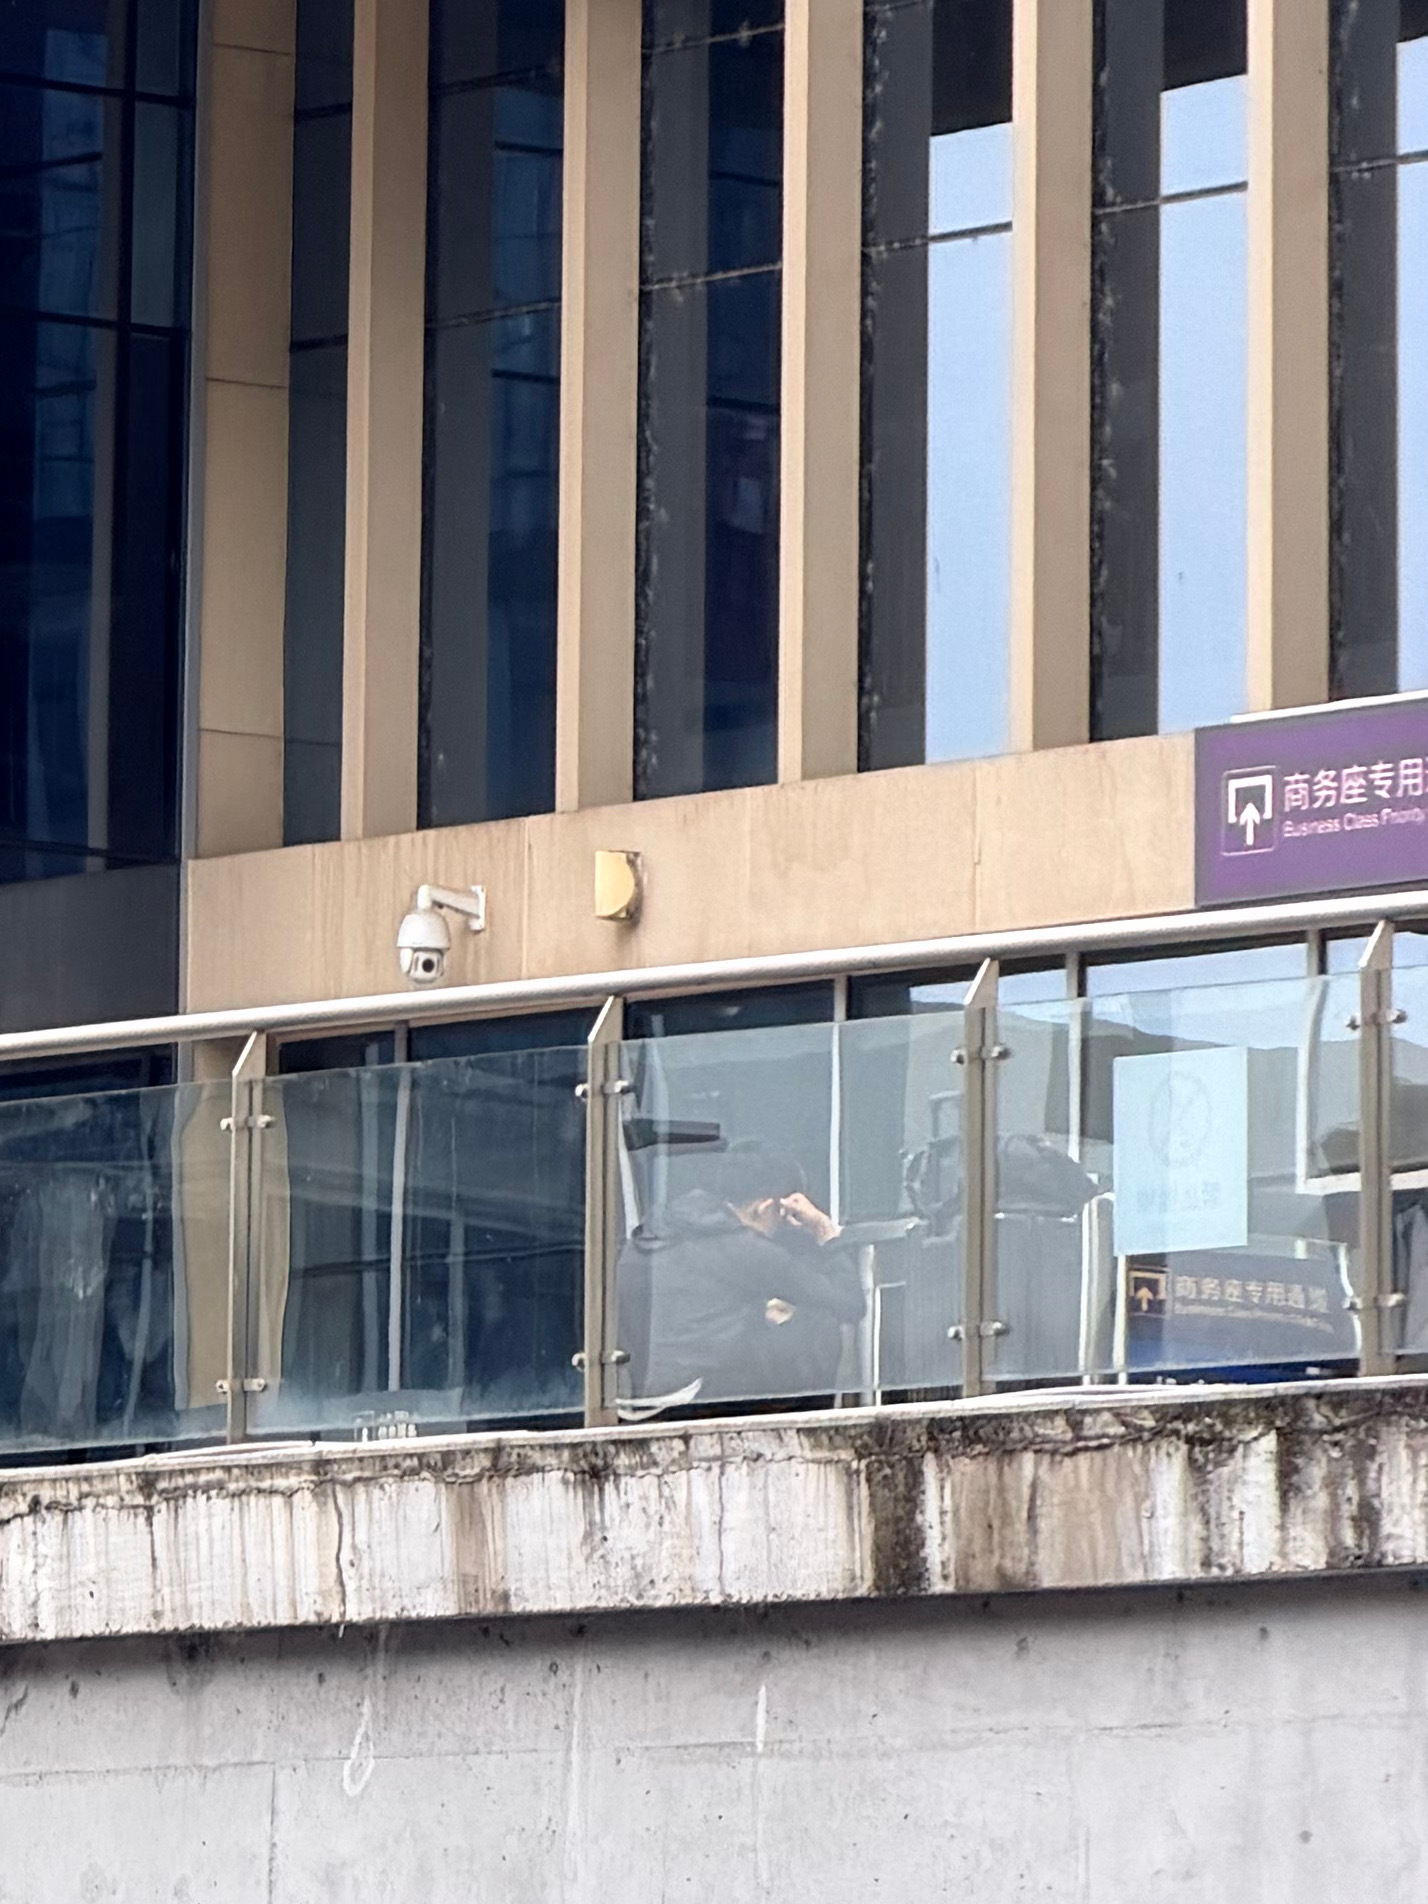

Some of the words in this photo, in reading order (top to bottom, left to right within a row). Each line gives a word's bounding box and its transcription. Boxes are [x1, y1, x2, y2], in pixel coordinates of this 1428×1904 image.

[1283, 757, 1428, 812] 商务座专用
